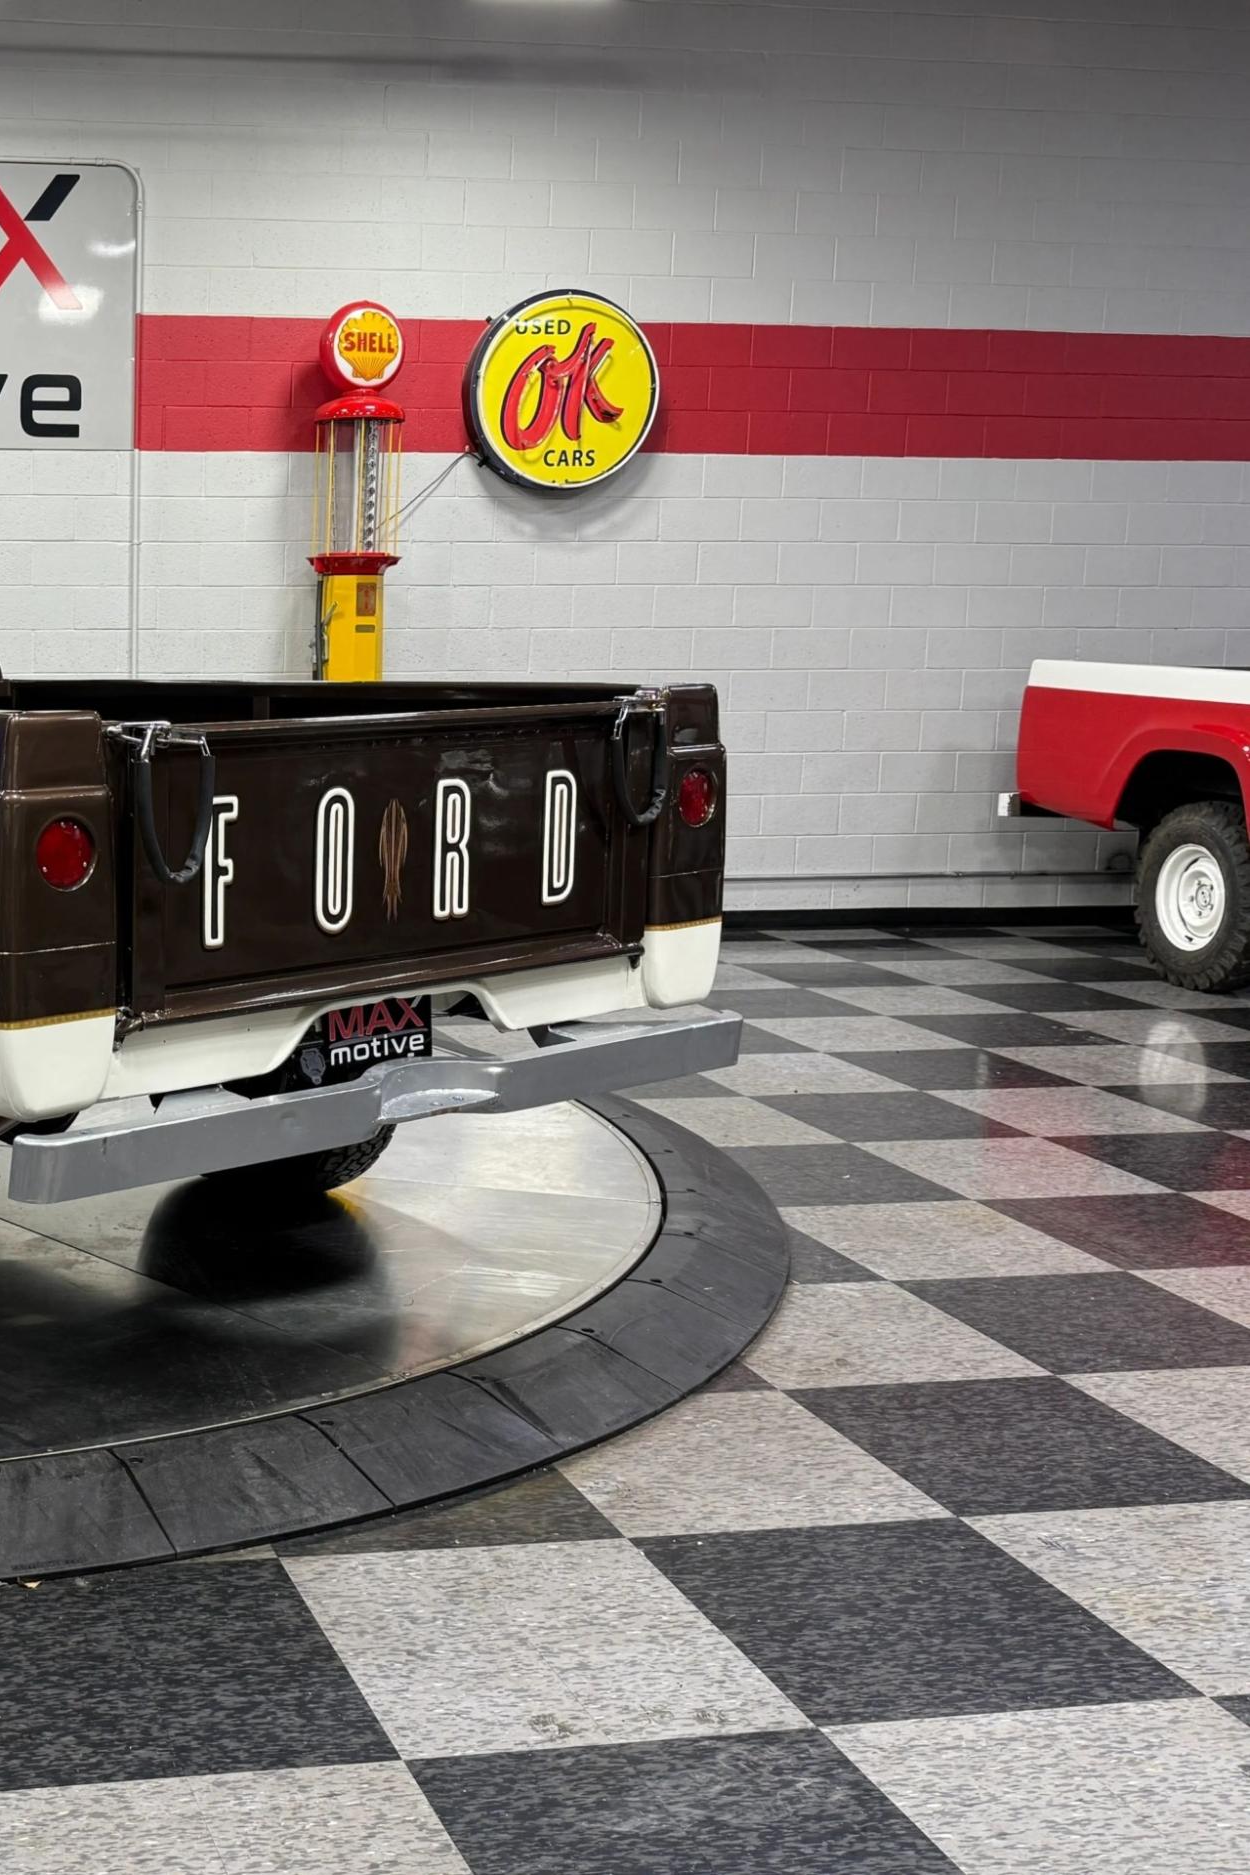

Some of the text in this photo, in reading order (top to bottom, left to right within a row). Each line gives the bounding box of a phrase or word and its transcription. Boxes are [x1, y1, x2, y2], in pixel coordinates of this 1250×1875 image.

[343, 331, 395, 354] SHELL
[515, 319, 571, 335] USED
[500, 322, 625, 451] OK
[543, 449, 596, 467] CARS
[201, 769, 578, 950] FORD
[328, 996, 425, 1042] MAX
[330, 1033, 425, 1066] motive
